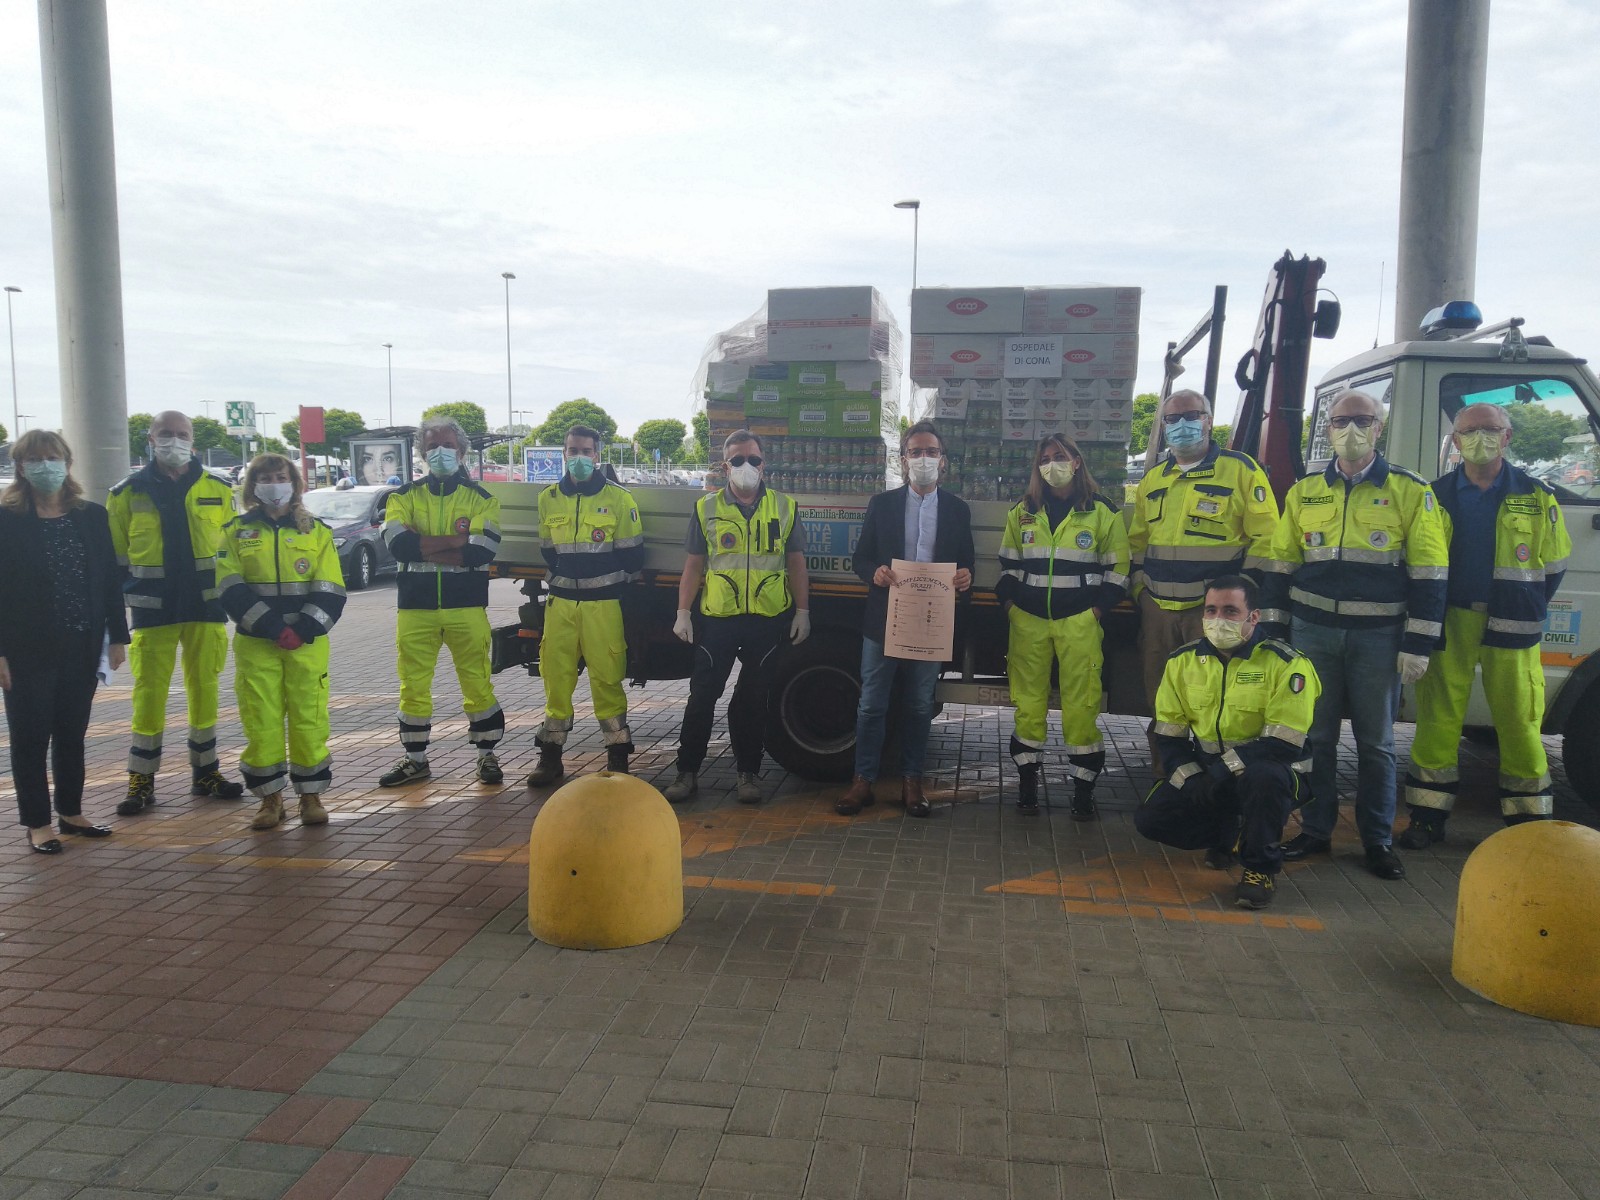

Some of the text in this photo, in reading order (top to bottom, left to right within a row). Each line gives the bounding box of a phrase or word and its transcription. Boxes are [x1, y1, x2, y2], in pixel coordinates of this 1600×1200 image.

[956, 302, 978, 311] coop
[1011, 343, 1055, 351] OSPEDALE
[957, 352, 974, 360] coop
[1071, 352, 1088, 360] coop
[1014, 356, 1051, 365] DI CONA
[1544, 632, 1576, 643] CIVILE
